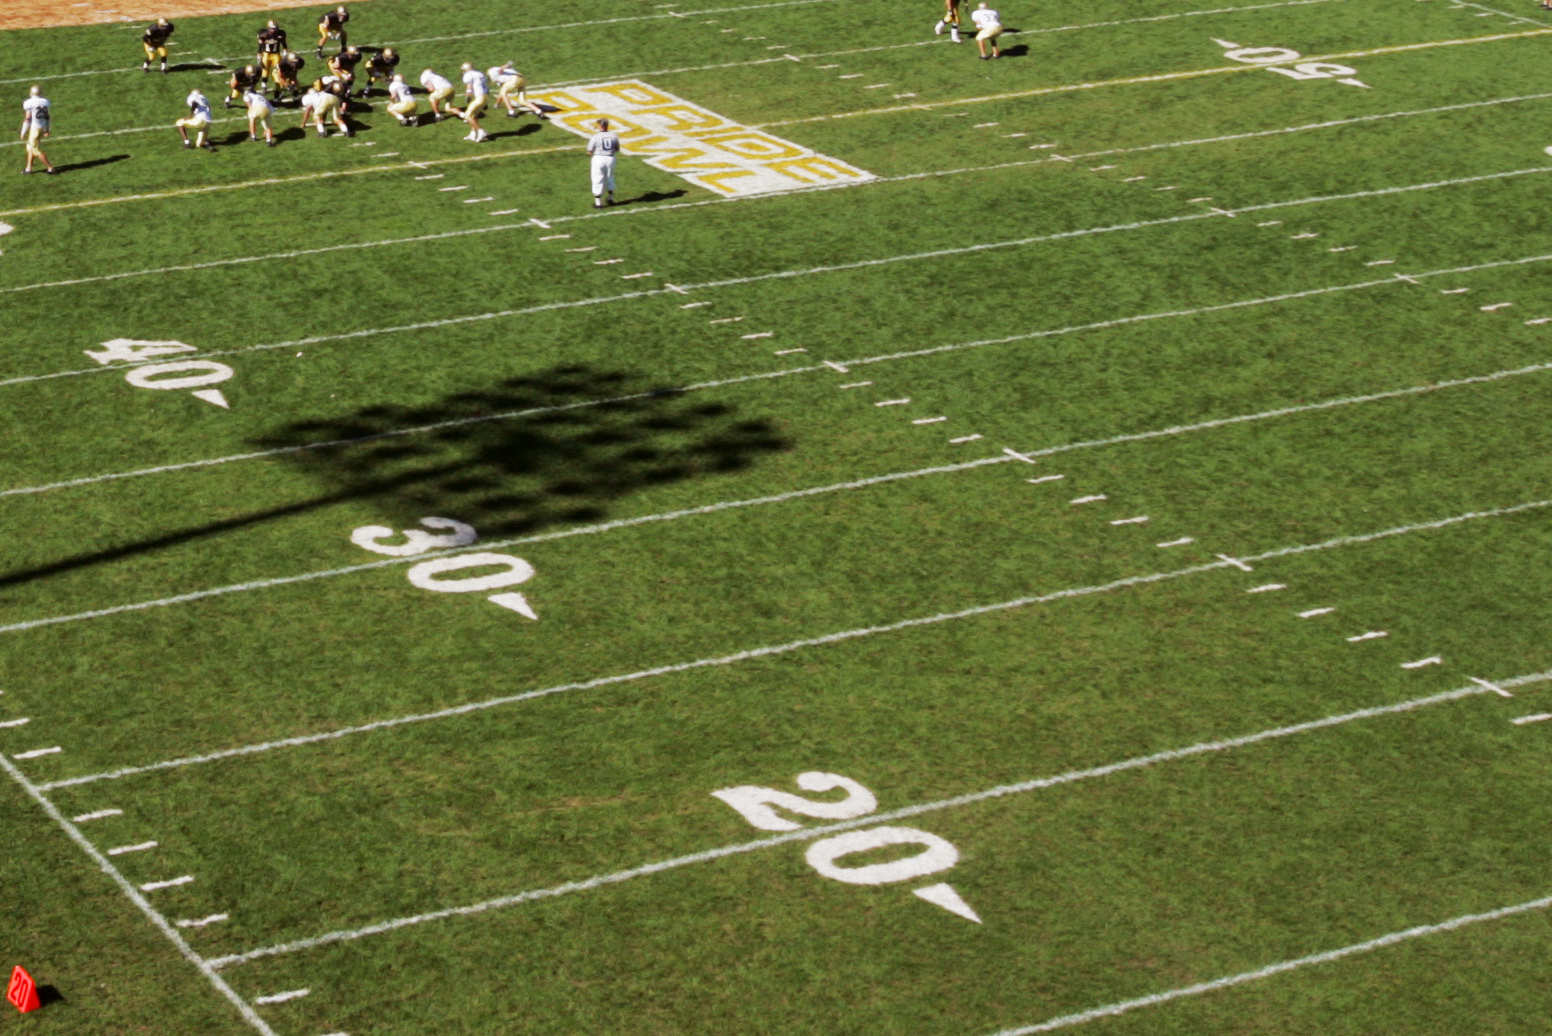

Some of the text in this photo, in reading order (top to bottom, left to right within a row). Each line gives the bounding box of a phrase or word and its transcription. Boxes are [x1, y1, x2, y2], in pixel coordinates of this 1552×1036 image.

[1225, 46, 1356, 81] 50
[581, 82, 862, 183] PRIDE
[84, 338, 233, 390] 40
[350, 516, 534, 593] 30
[711, 771, 959, 885] 20
[10, 971, 32, 1008] 20
